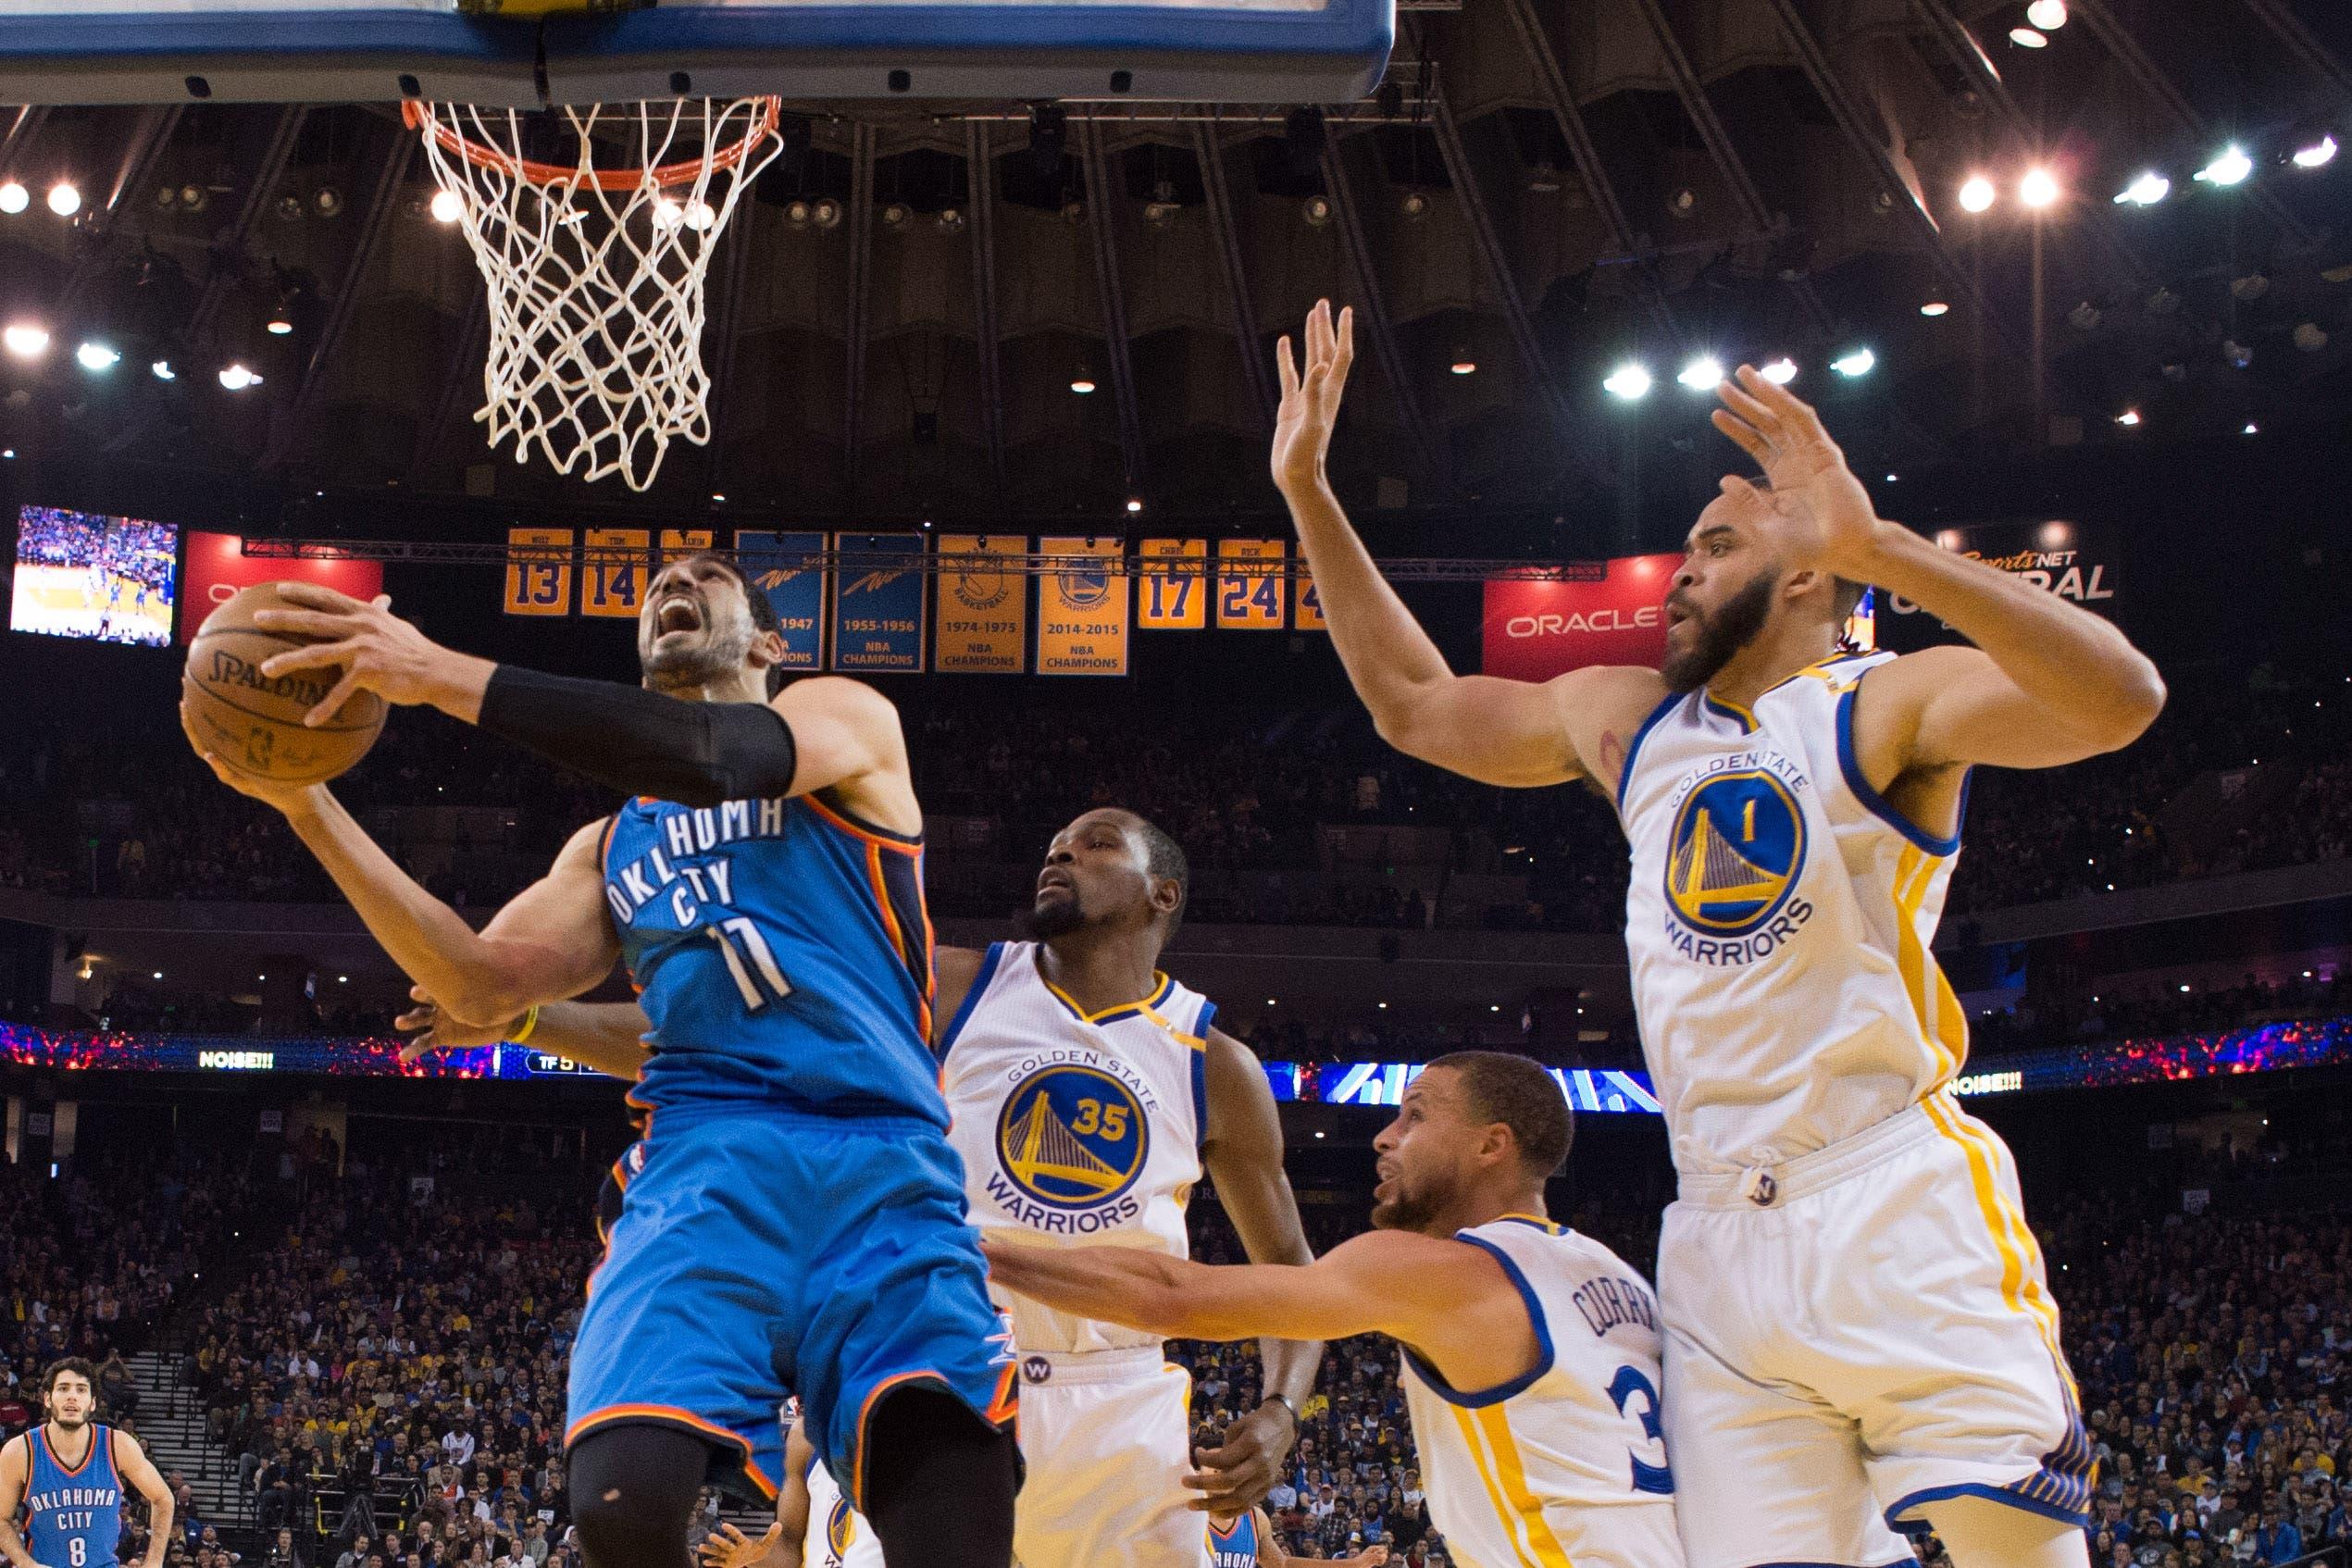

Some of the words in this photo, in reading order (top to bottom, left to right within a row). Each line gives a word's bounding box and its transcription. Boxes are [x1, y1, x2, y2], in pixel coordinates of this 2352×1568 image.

[516, 560, 561, 604] 13
[592, 560, 636, 606] 14
[1150, 572, 1194, 617] 17
[1223, 573, 1278, 617] 24
[843, 619, 915, 632] 1955-1956
[945, 621, 1016, 633] 1974-1975
[1047, 623, 1119, 635] 2014-2015
[1505, 606, 1660, 639] ORACLE
[842, 653, 913, 666] CHAMPIONS
[865, 641, 890, 653] NBA
[944, 655, 1014, 667] CHAMPIONS
[967, 643, 992, 653] NBA
[1069, 645, 1094, 655] NBA
[1046, 657, 1118, 668] CHAMPIONS
[1670, 752, 1760, 809] GOLDEN
[1742, 798, 1758, 842] 1
[671, 857, 734, 927] CTY
[1664, 896, 1813, 966] WARRIORS
[199, 1051, 274, 1070] NOISE!!!
[539, 1055, 558, 1070] TF
[559, 1055, 574, 1071] 5
[1007, 1050, 1099, 1083] GOLDEN
[1106, 1059, 1160, 1114] STATE
[1071, 1098, 1130, 1142] 35
[985, 1171, 1139, 1235] WARRIORS
[31, 1487, 117, 1512] OKLAHOMA
[56, 1511, 93, 1531] CITY
[68, 1537, 87, 1568] 8
